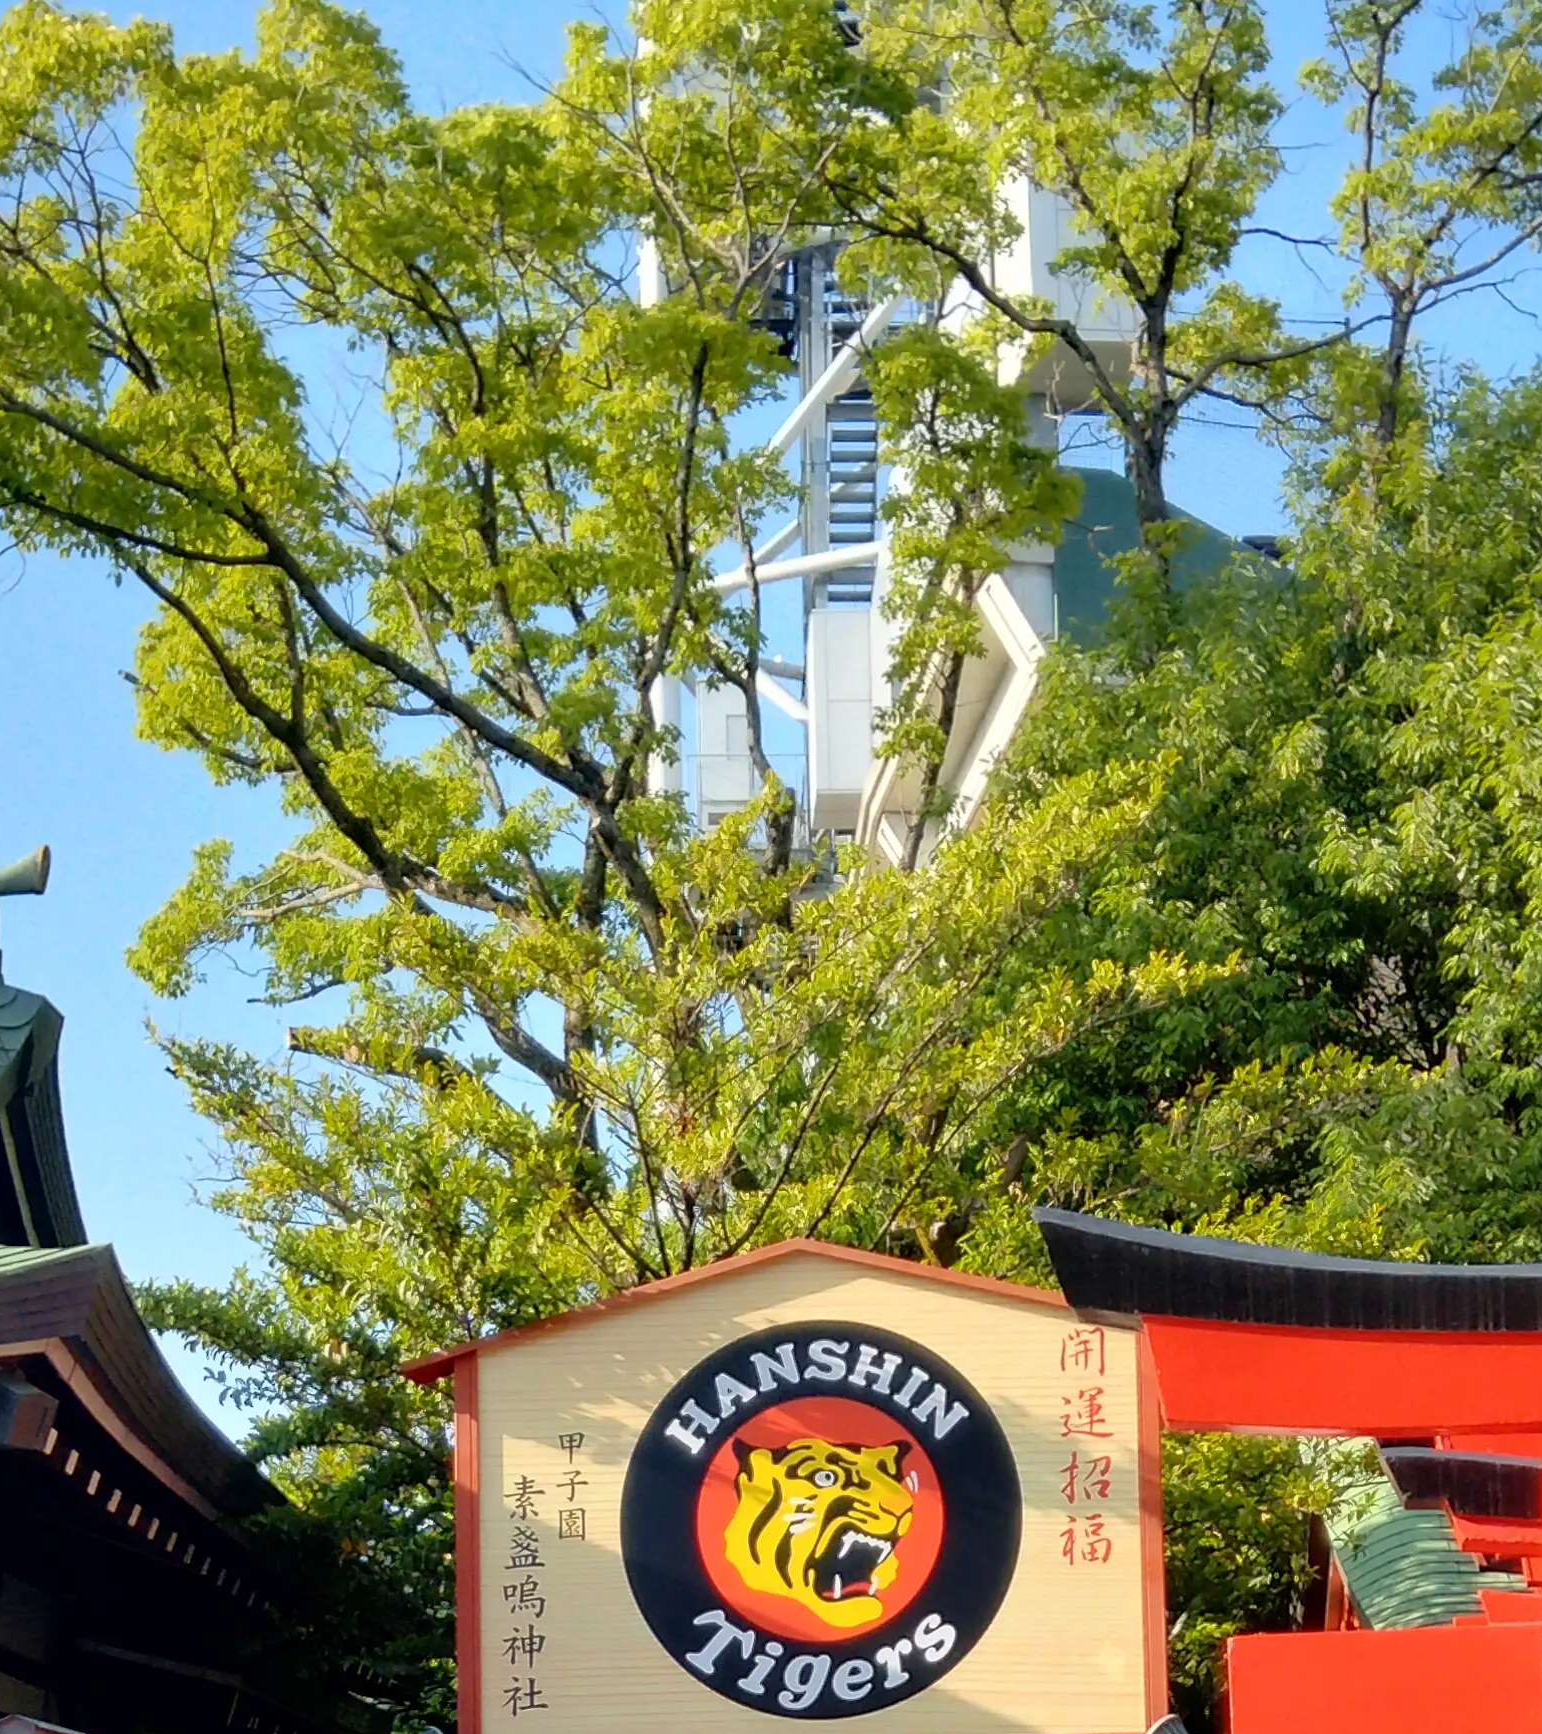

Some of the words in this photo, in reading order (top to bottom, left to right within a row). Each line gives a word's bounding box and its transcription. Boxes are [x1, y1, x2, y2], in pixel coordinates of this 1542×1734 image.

[664, 1339, 970, 1456] HANSHIN
[1059, 1326, 1114, 1567] 開運招福
[555, 1431, 590, 1542] 甲子園
[684, 1608, 959, 1711] Tigers
